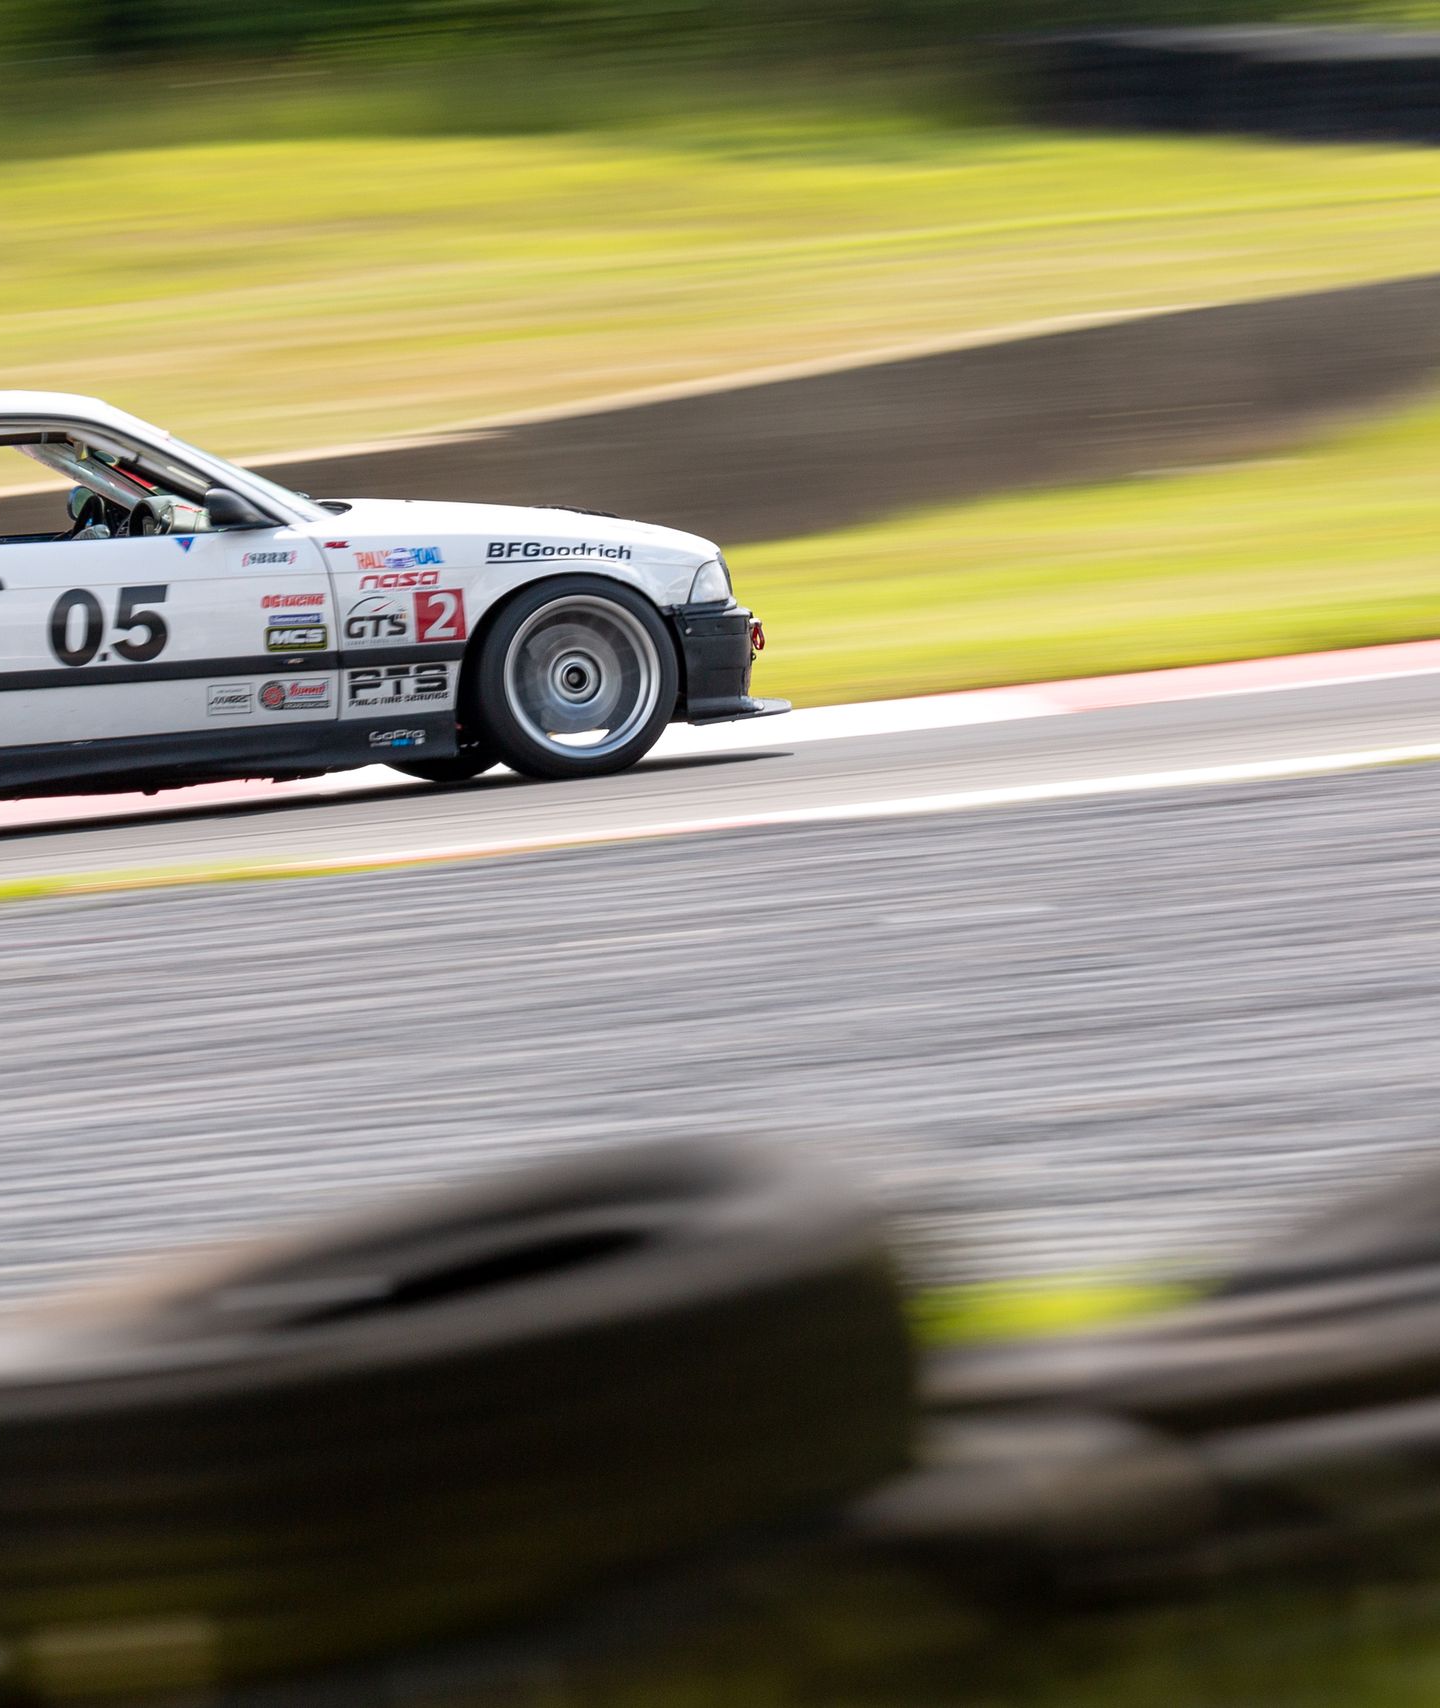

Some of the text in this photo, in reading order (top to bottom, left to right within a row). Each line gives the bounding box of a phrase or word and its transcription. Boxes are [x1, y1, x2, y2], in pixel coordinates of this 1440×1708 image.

[486, 542, 632, 560] BFGoodrich
[359, 571, 440, 591] nasa
[47, 584, 169, 667] 0.5
[344, 613, 407, 639] GTS
[423, 592, 458, 640] 2
[268, 628, 326, 646] MCS
[348, 664, 449, 699] PTS
[369, 729, 426, 742] GoPro
